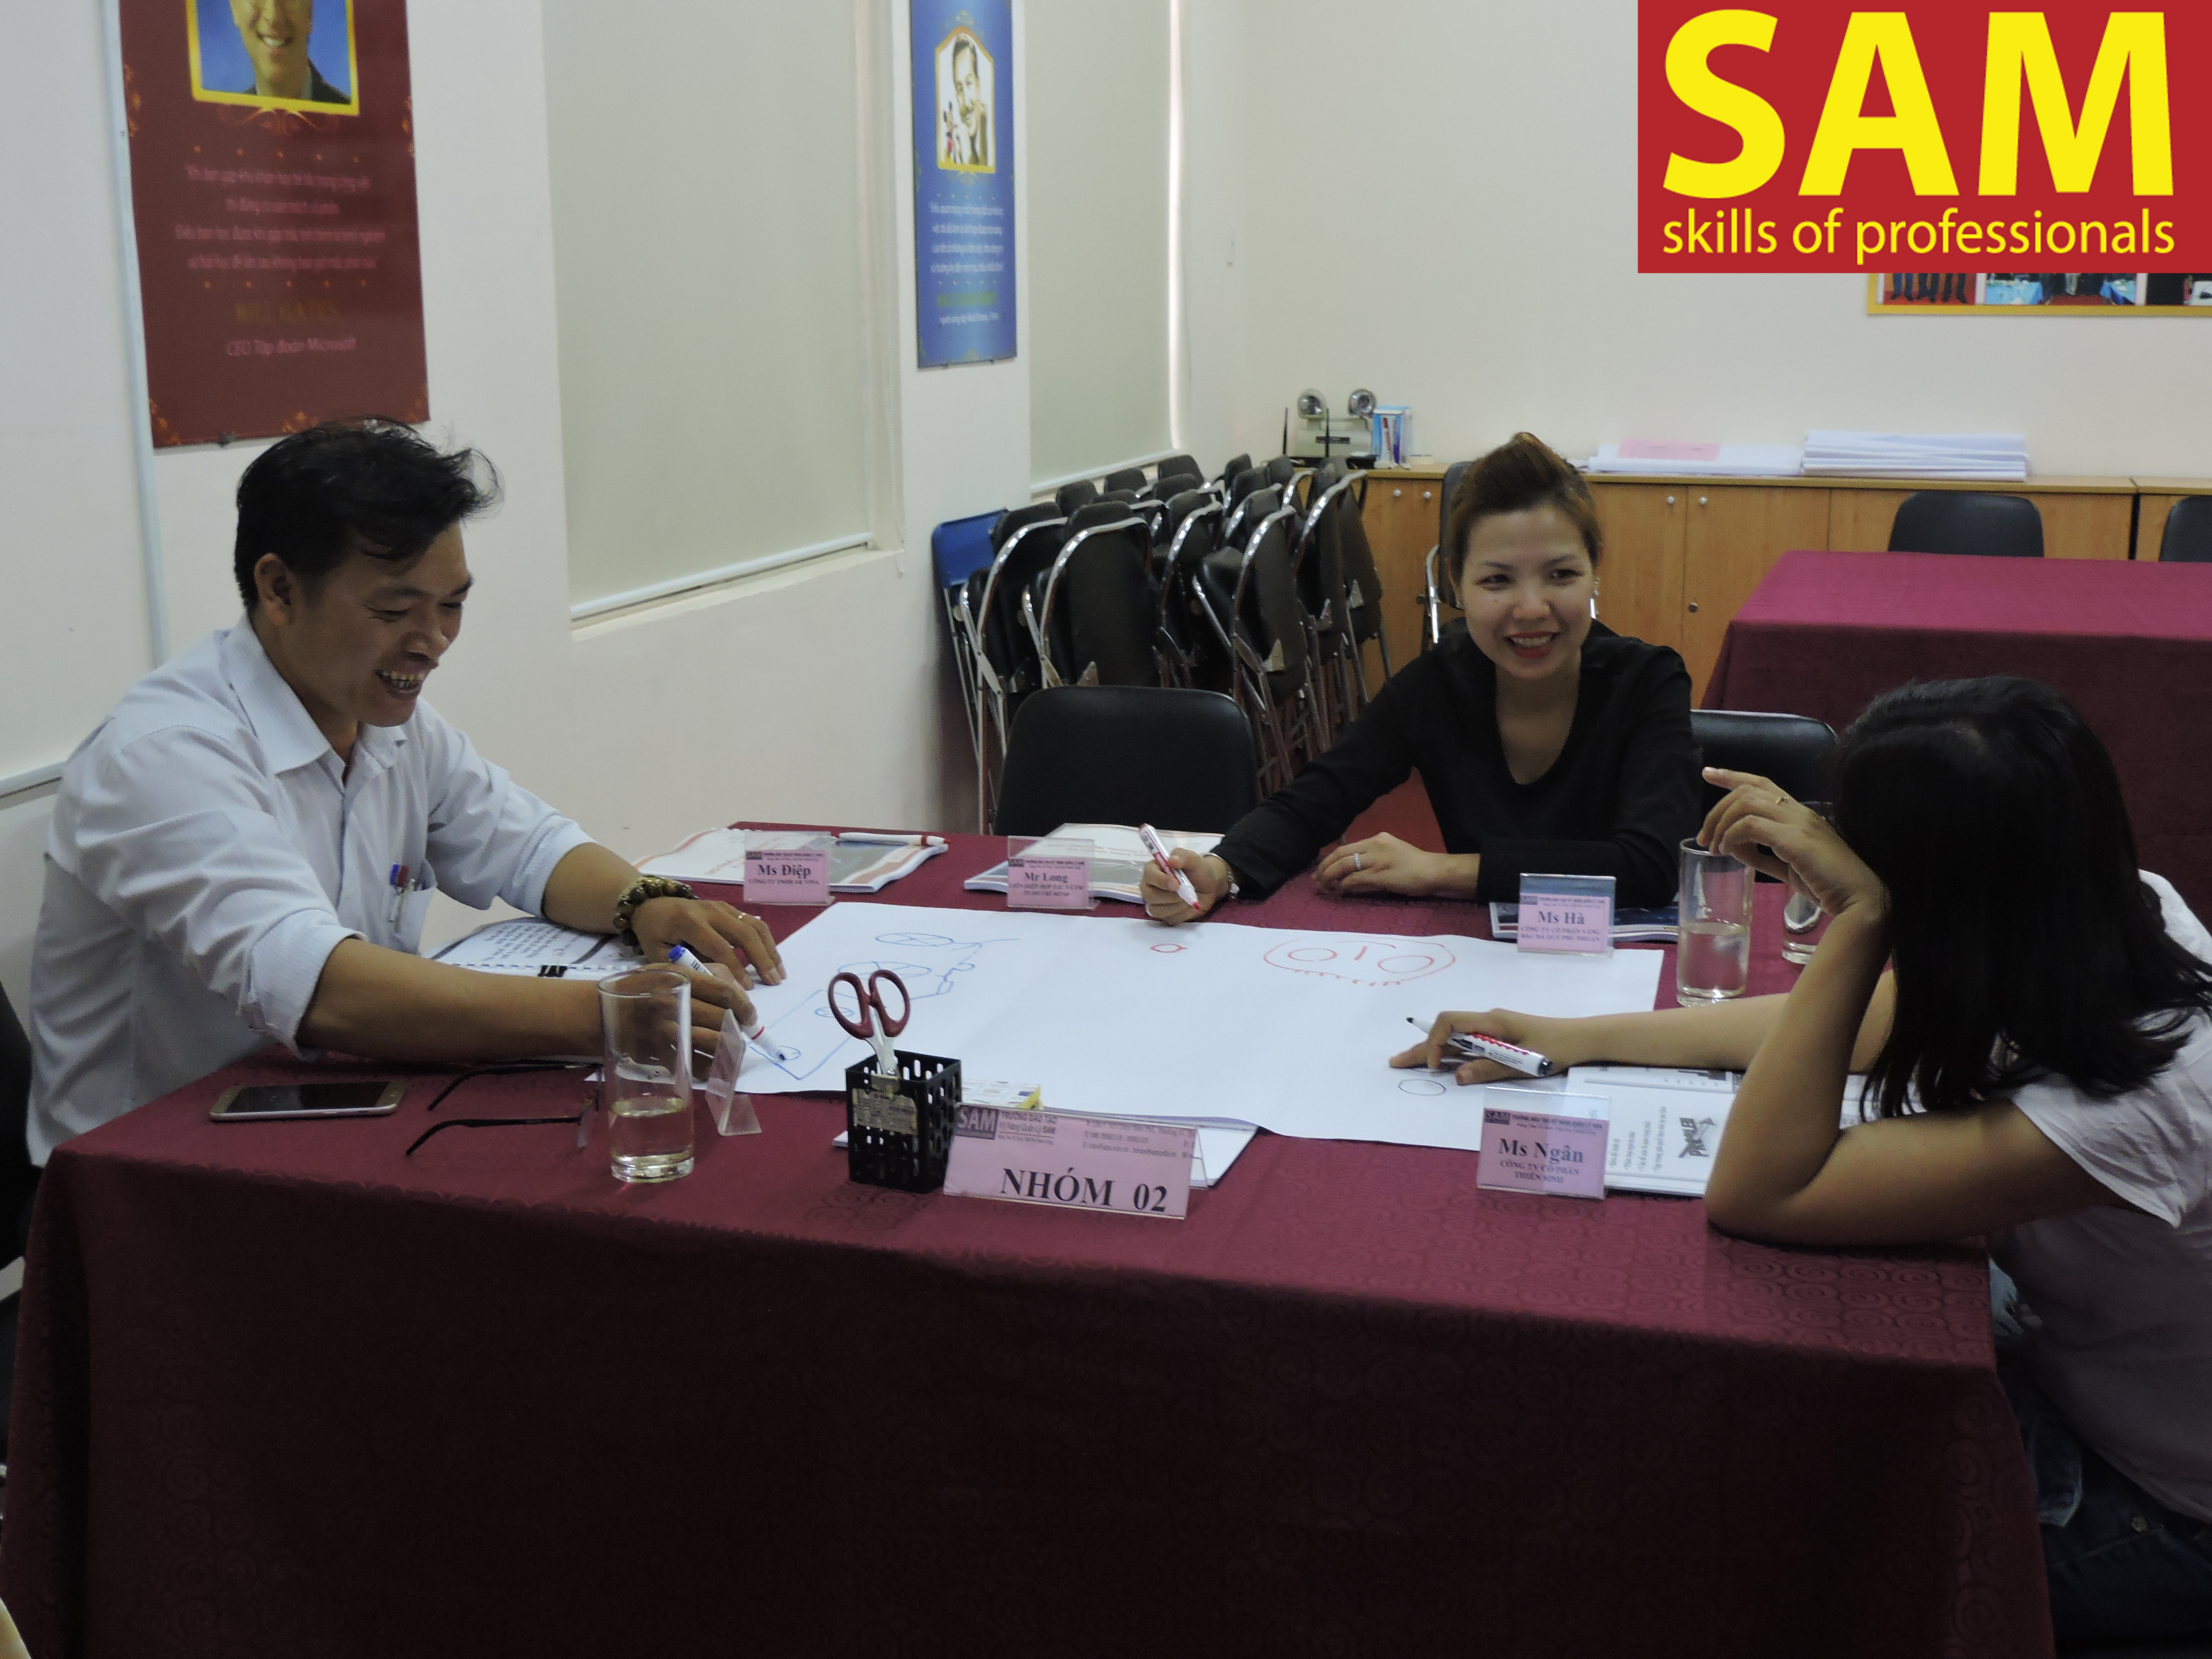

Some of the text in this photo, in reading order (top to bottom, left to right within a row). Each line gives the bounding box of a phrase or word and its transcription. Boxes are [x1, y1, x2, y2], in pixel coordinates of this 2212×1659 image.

[757, 864, 777, 876] Ms
[1025, 872, 1069, 884] Mr Long
[1538, 911, 1585, 925] Ms Hà
[958, 1106, 996, 1132] SAM
[1498, 1138, 1584, 1164] Ms Ngân
[1500, 1159, 1525, 1169] CÔNG
[1001, 1167, 1167, 1213] NHÓM 02
